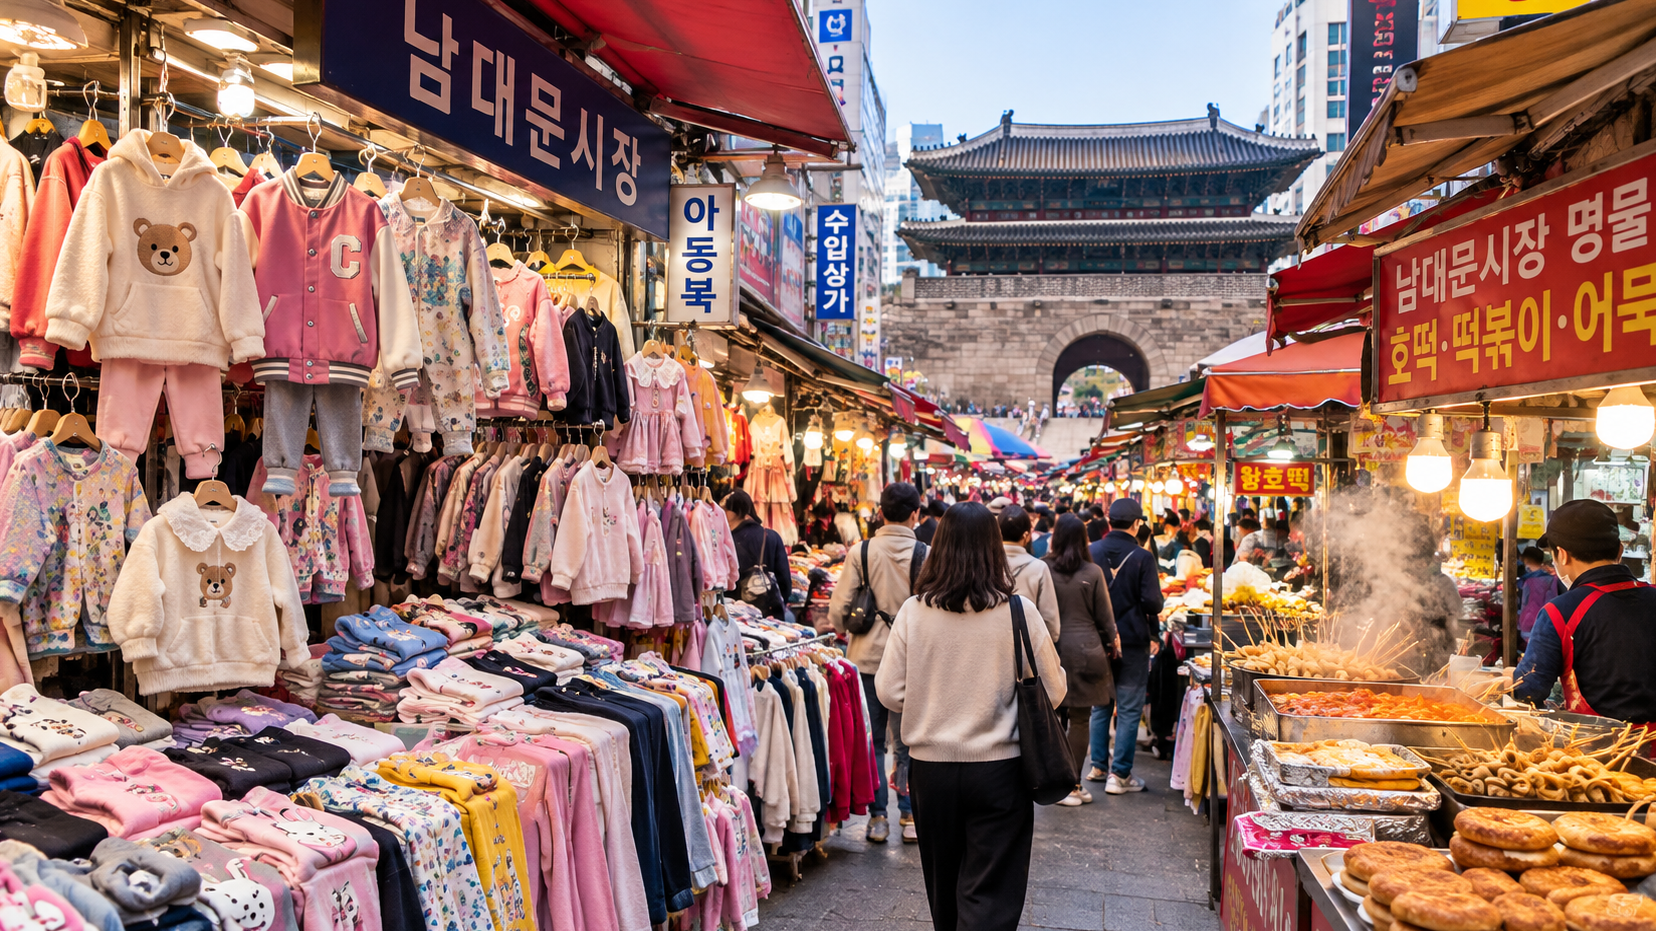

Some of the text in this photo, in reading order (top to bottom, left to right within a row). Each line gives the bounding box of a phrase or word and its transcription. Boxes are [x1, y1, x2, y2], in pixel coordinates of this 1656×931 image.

[404, 0, 642, 206] 남대문시장
[330, 234, 362, 279] C
[823, 209, 850, 313] 수입상가
[1396, 177, 1652, 314] 남대문시장 명물
